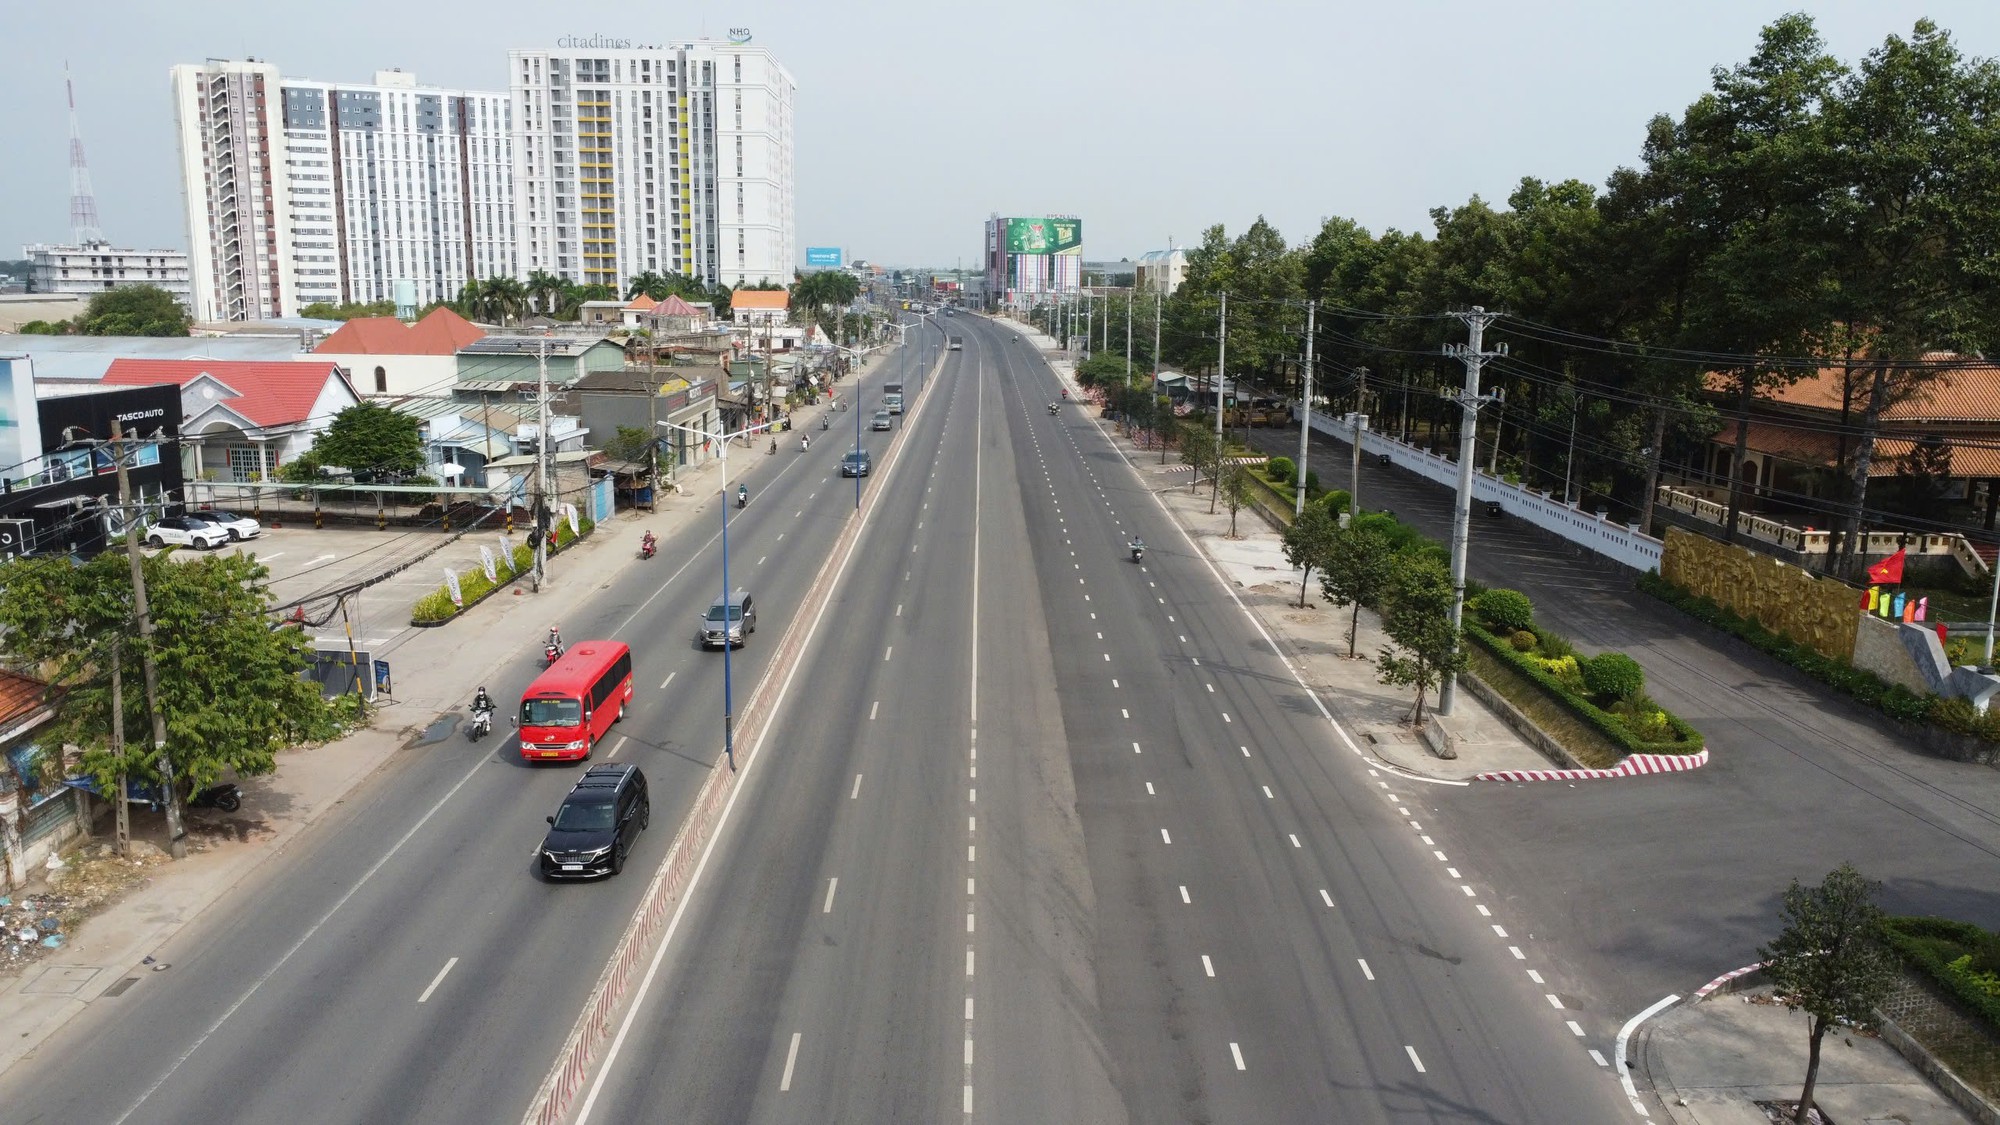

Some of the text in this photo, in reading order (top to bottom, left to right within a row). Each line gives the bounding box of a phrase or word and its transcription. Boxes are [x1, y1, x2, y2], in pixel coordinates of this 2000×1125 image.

[557, 33, 631, 49] citadines
[116, 408, 164, 422] TASCO AUTO
